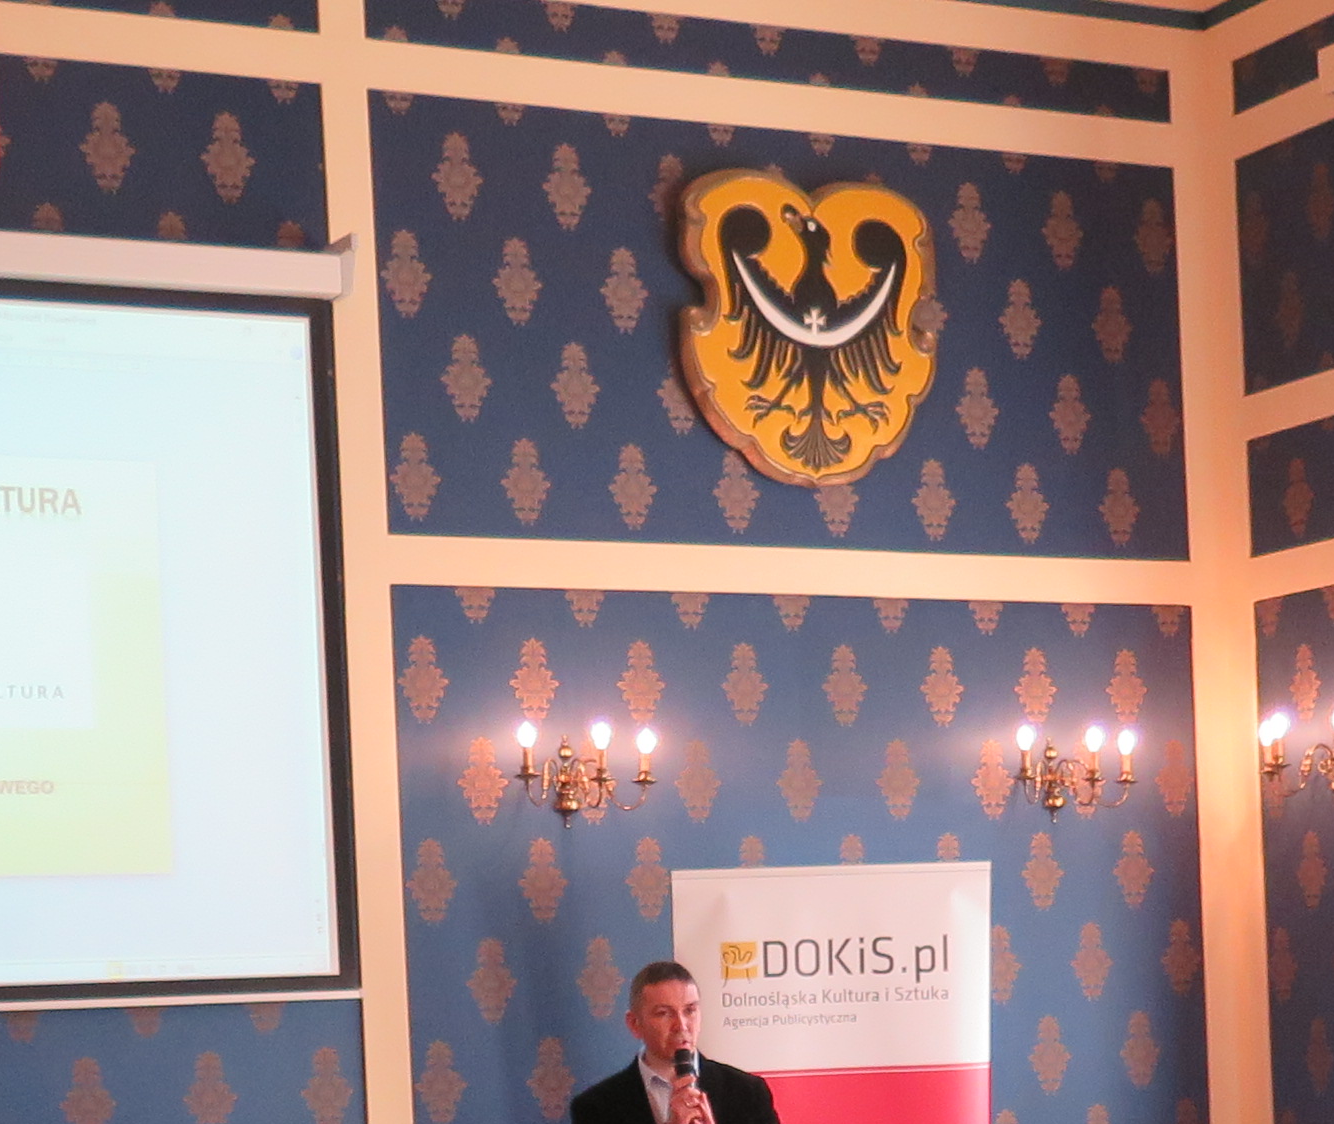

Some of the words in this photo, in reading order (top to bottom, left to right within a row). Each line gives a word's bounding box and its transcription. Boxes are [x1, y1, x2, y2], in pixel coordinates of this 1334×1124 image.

[763, 934, 949, 984] DOKiS.pl
[721, 989, 818, 1009] Dolnośląska
[821, 988, 881, 1004] Kultura
[884, 987, 890, 1002] i
[894, 984, 950, 1002] Sztuka
[722, 1016, 770, 1031] Agencja
[771, 1012, 858, 1028] Publicystyczna
